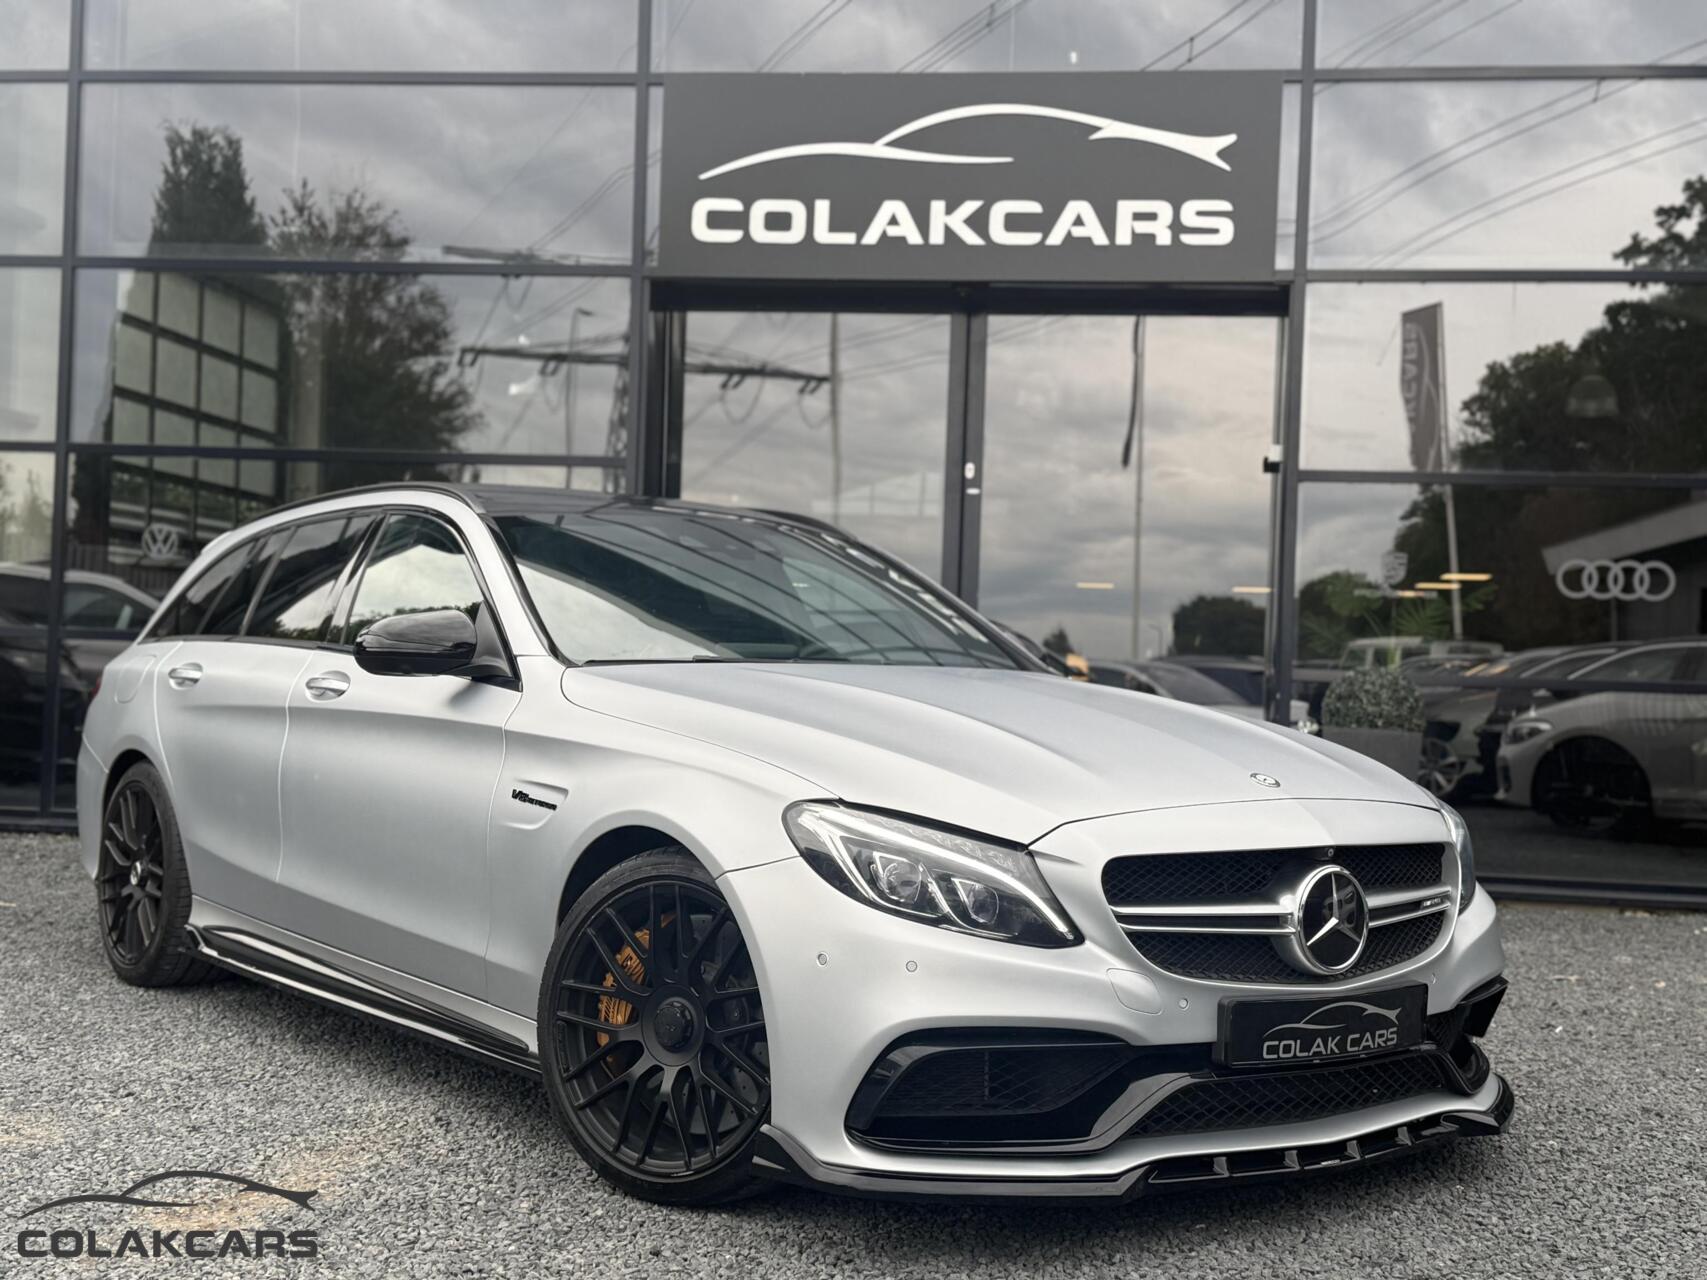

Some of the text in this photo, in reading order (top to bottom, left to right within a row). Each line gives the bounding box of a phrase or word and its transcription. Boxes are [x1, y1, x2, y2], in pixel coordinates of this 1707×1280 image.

[691, 197, 1235, 246] COLAKCARS
[1263, 1027, 1398, 1059] COLAK CARS
